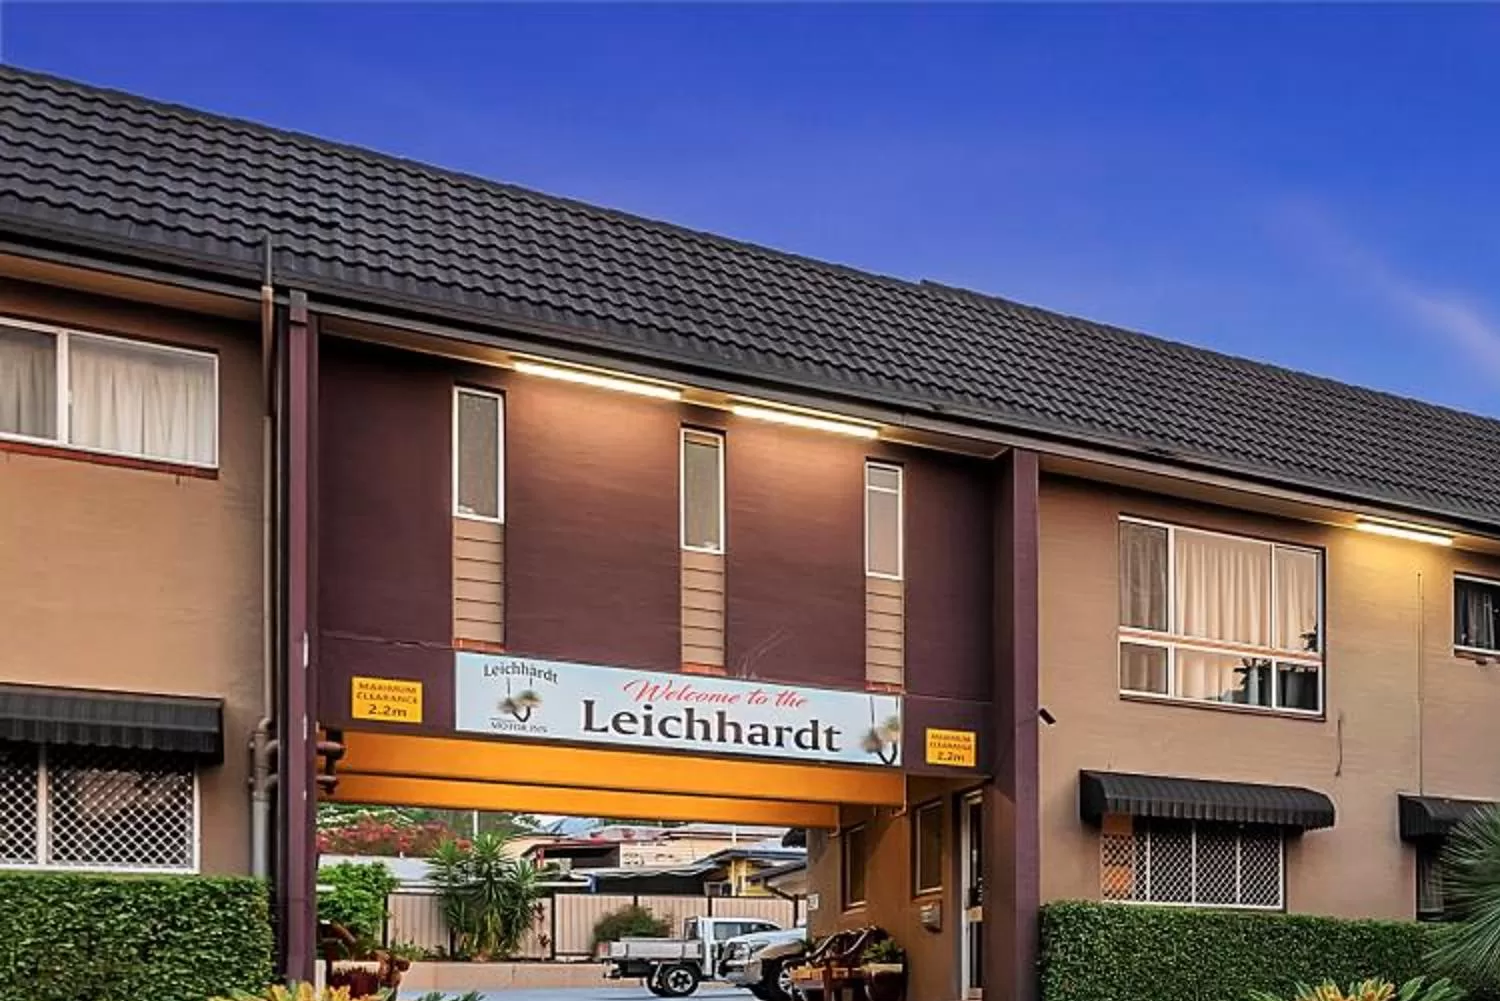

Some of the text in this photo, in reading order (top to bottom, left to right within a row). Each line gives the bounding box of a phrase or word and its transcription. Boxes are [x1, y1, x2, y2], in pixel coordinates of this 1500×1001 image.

[484, 662, 558, 684] Leichhardt
[623, 679, 809, 709] Welcome to the
[368, 704, 407, 718] 2.2m
[583, 699, 842, 752] Leichhardt
